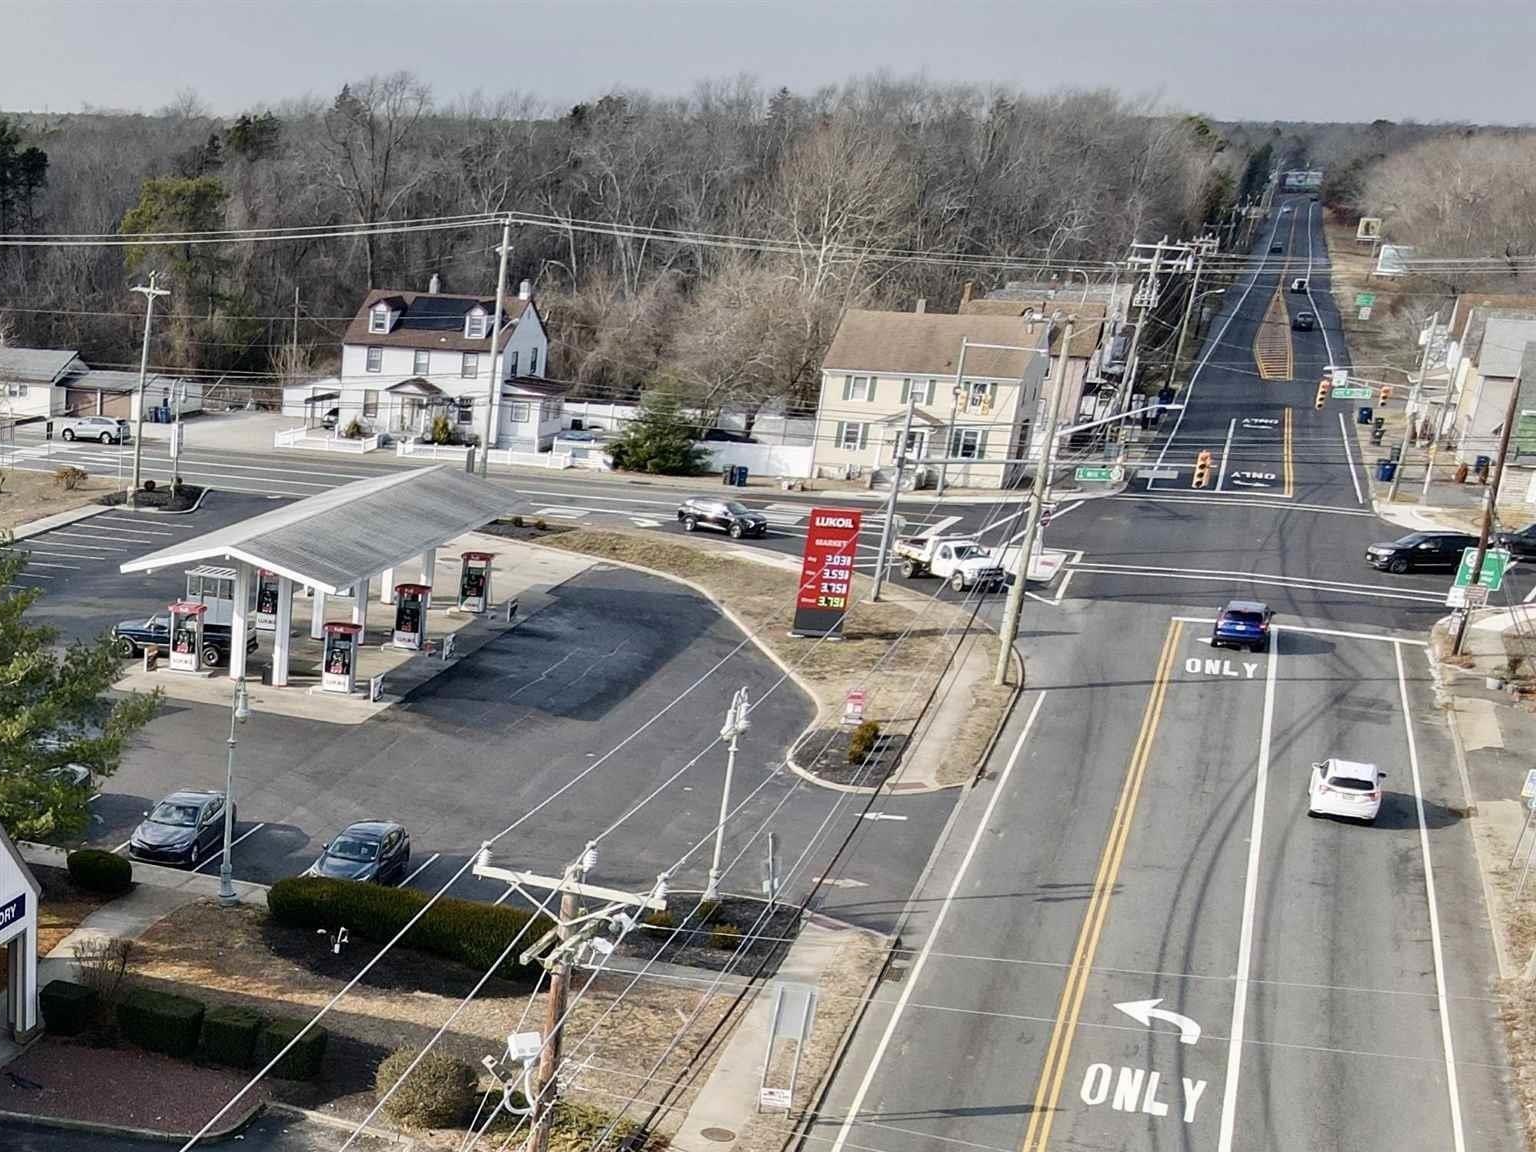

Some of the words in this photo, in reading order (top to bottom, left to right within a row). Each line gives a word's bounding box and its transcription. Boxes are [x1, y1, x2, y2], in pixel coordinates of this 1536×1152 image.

[1230, 471, 1276, 480] ONLY
[815, 516, 854, 529] LUKOIL
[1185, 658, 1258, 679] ONLY
[1080, 1063, 1207, 1124] ONLY
